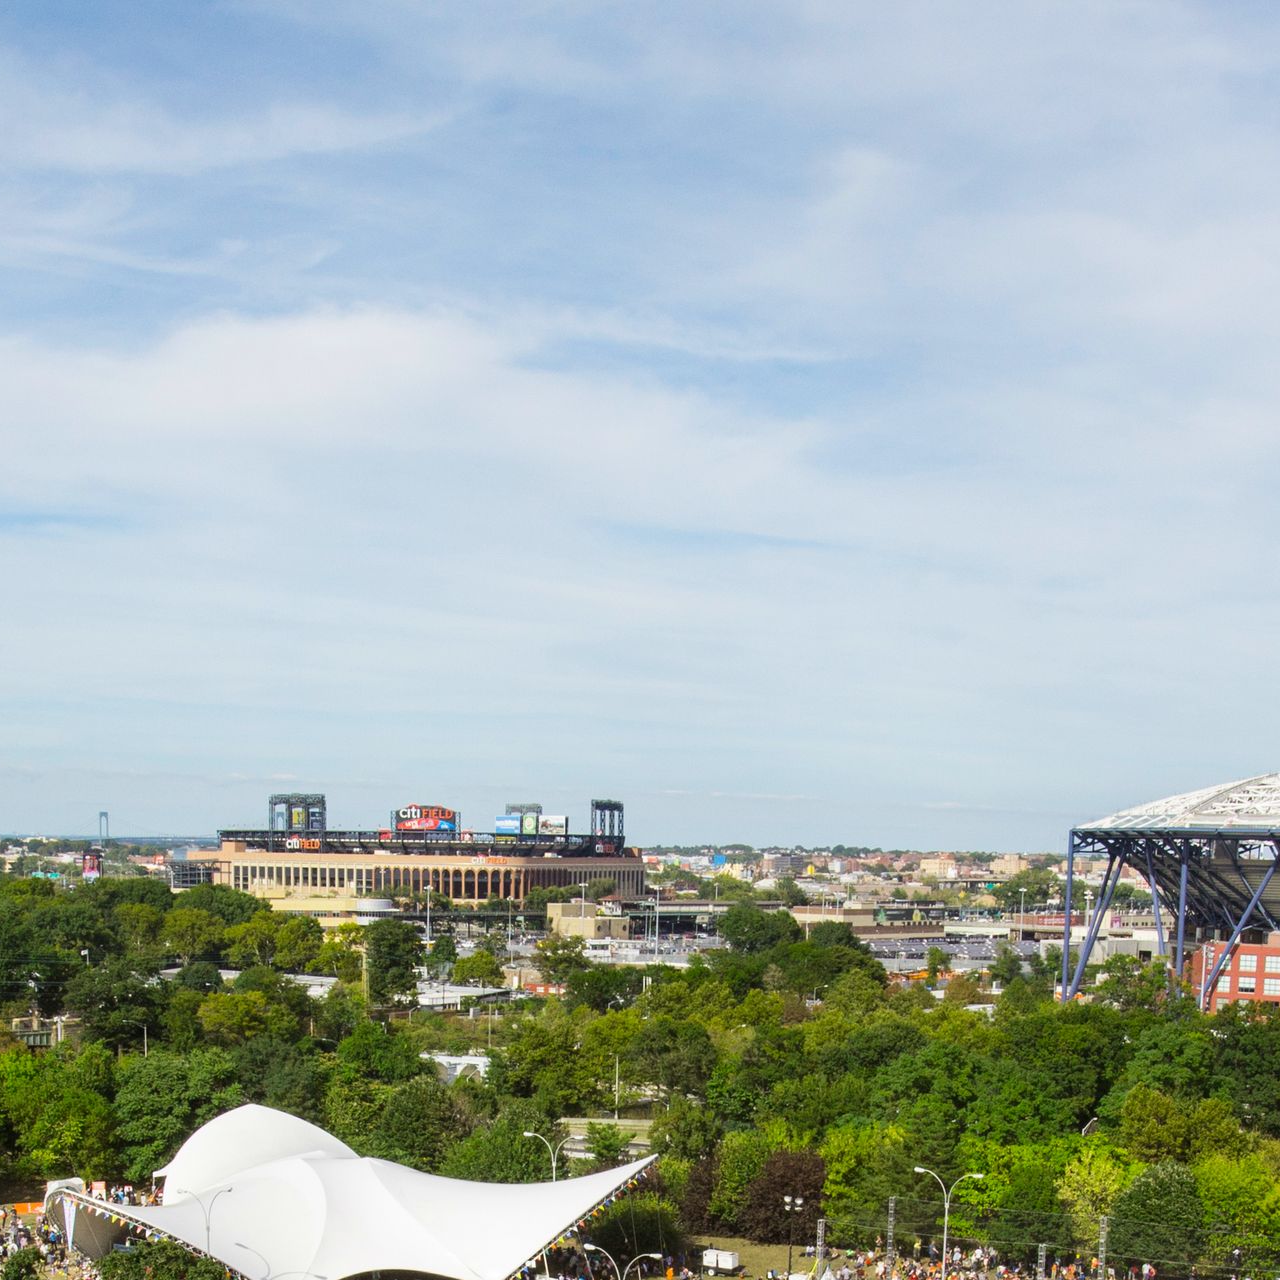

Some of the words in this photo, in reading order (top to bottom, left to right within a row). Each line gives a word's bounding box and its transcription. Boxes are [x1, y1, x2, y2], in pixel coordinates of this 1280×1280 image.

[399, 806, 420, 819] citi
[422, 808, 453, 819] FIELD
[300, 840, 320, 849] FIELD
